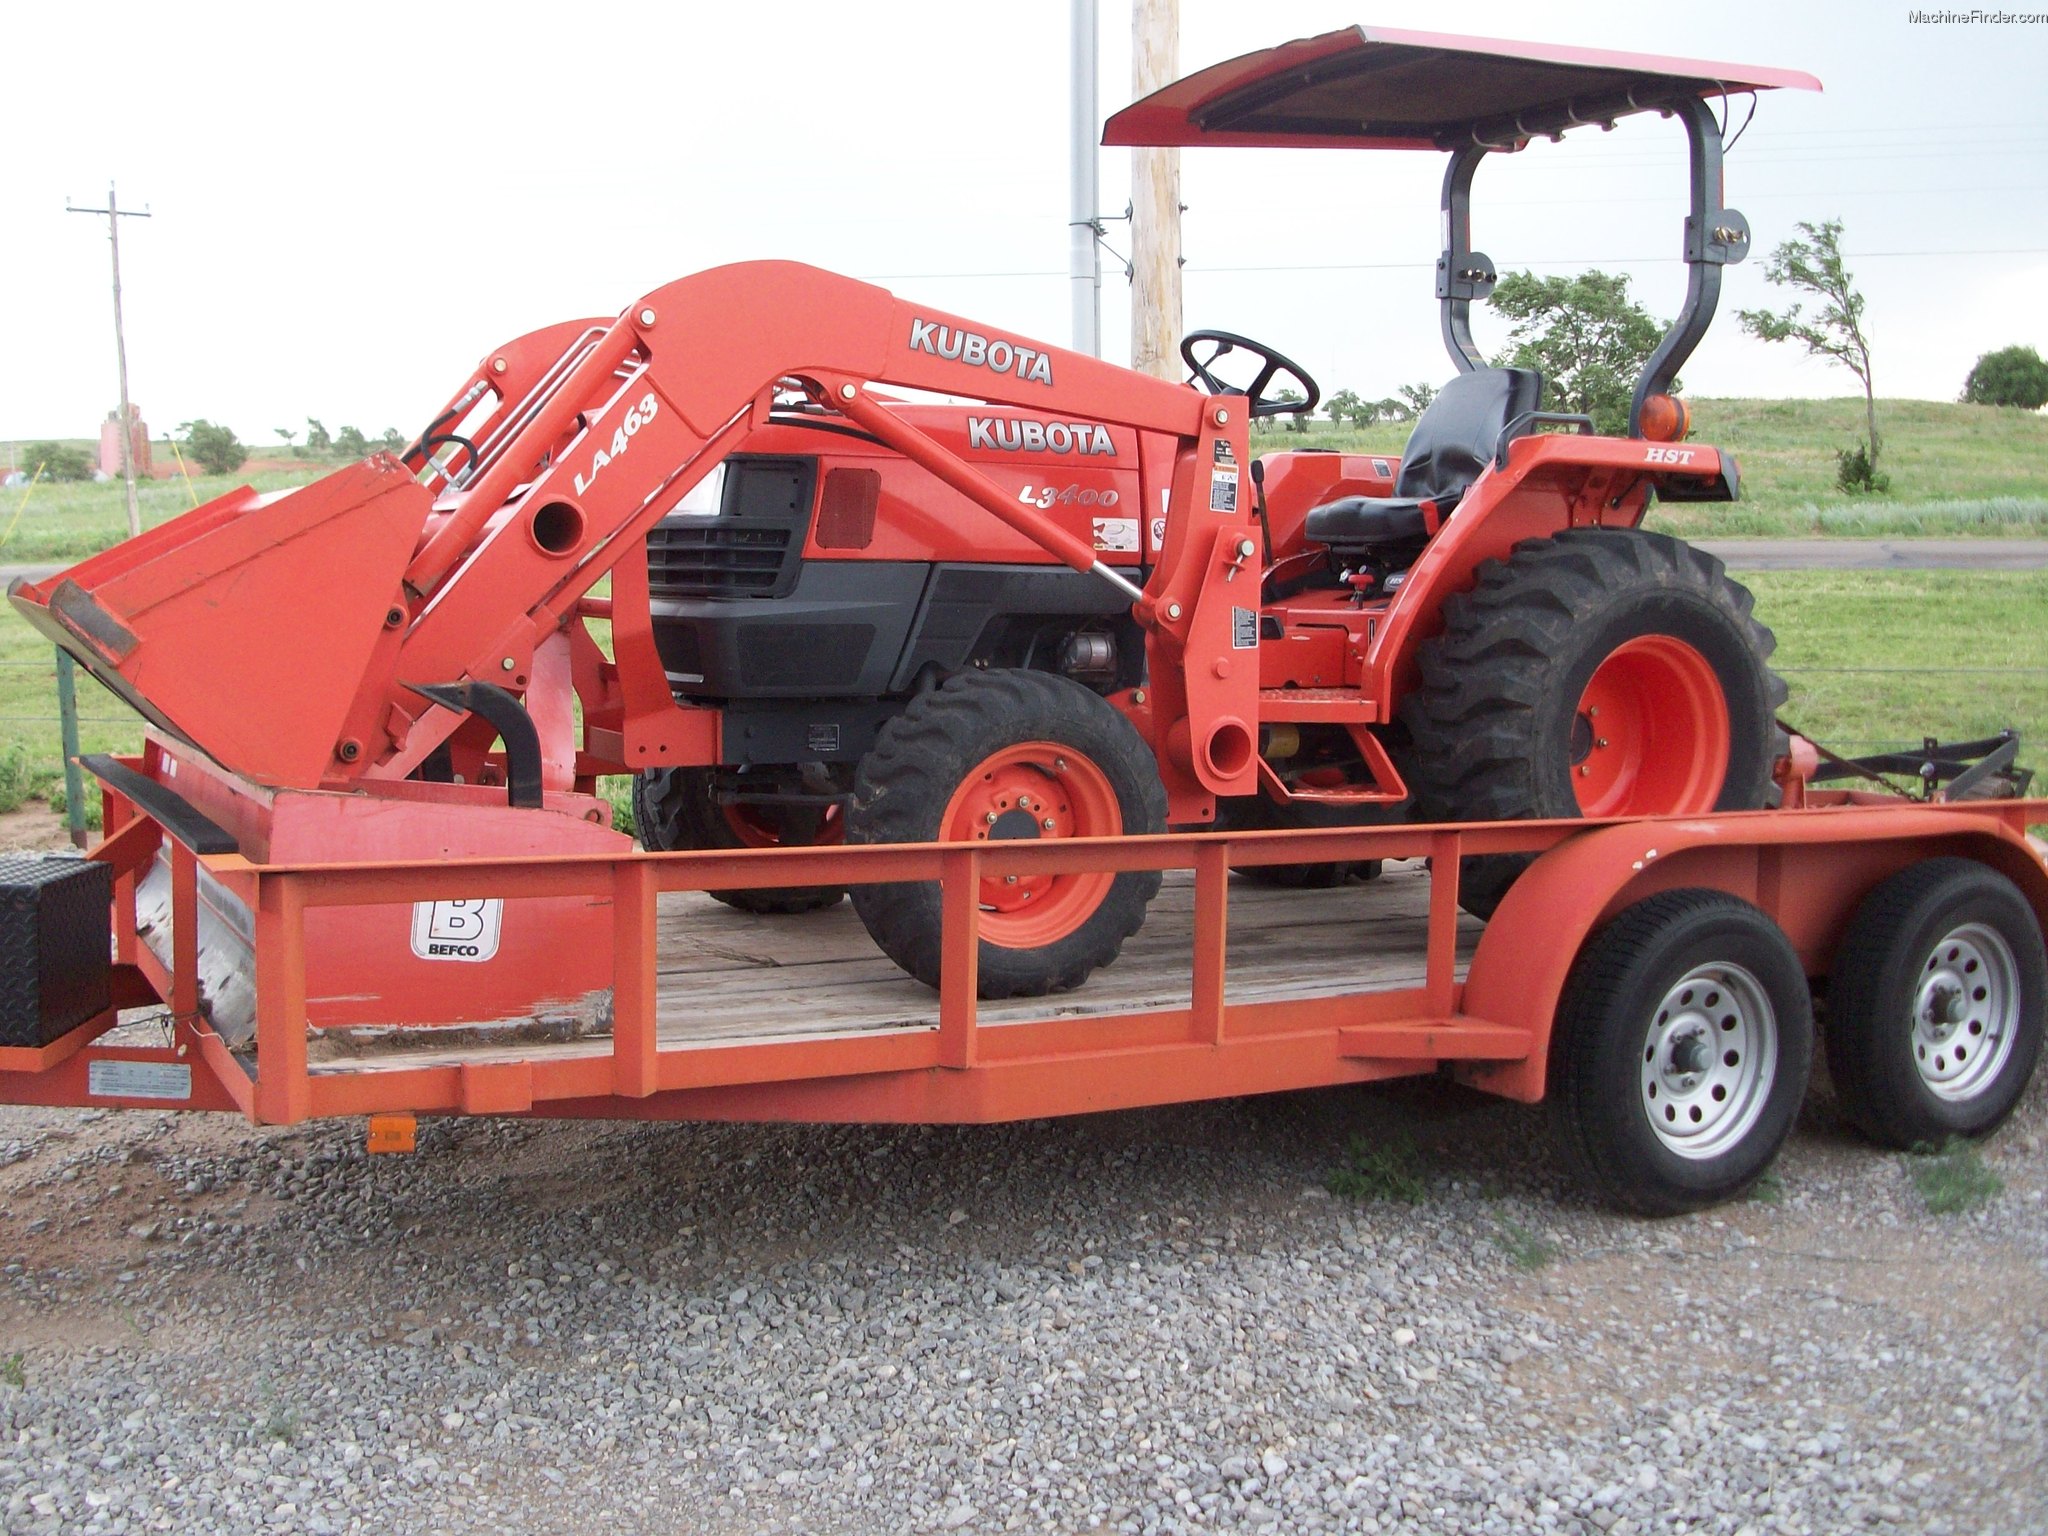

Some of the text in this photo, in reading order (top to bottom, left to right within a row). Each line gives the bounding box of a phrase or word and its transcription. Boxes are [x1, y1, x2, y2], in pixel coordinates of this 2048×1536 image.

[909, 317, 1053, 386] KUBOTA
[573, 392, 659, 497] LA463
[968, 416, 1117, 456] KUBOTA
[1644, 447, 1695, 465] HST
[1018, 484, 1119, 509] L3400
[428, 899, 485, 940] B
[428, 943, 479, 957] BEFCO
